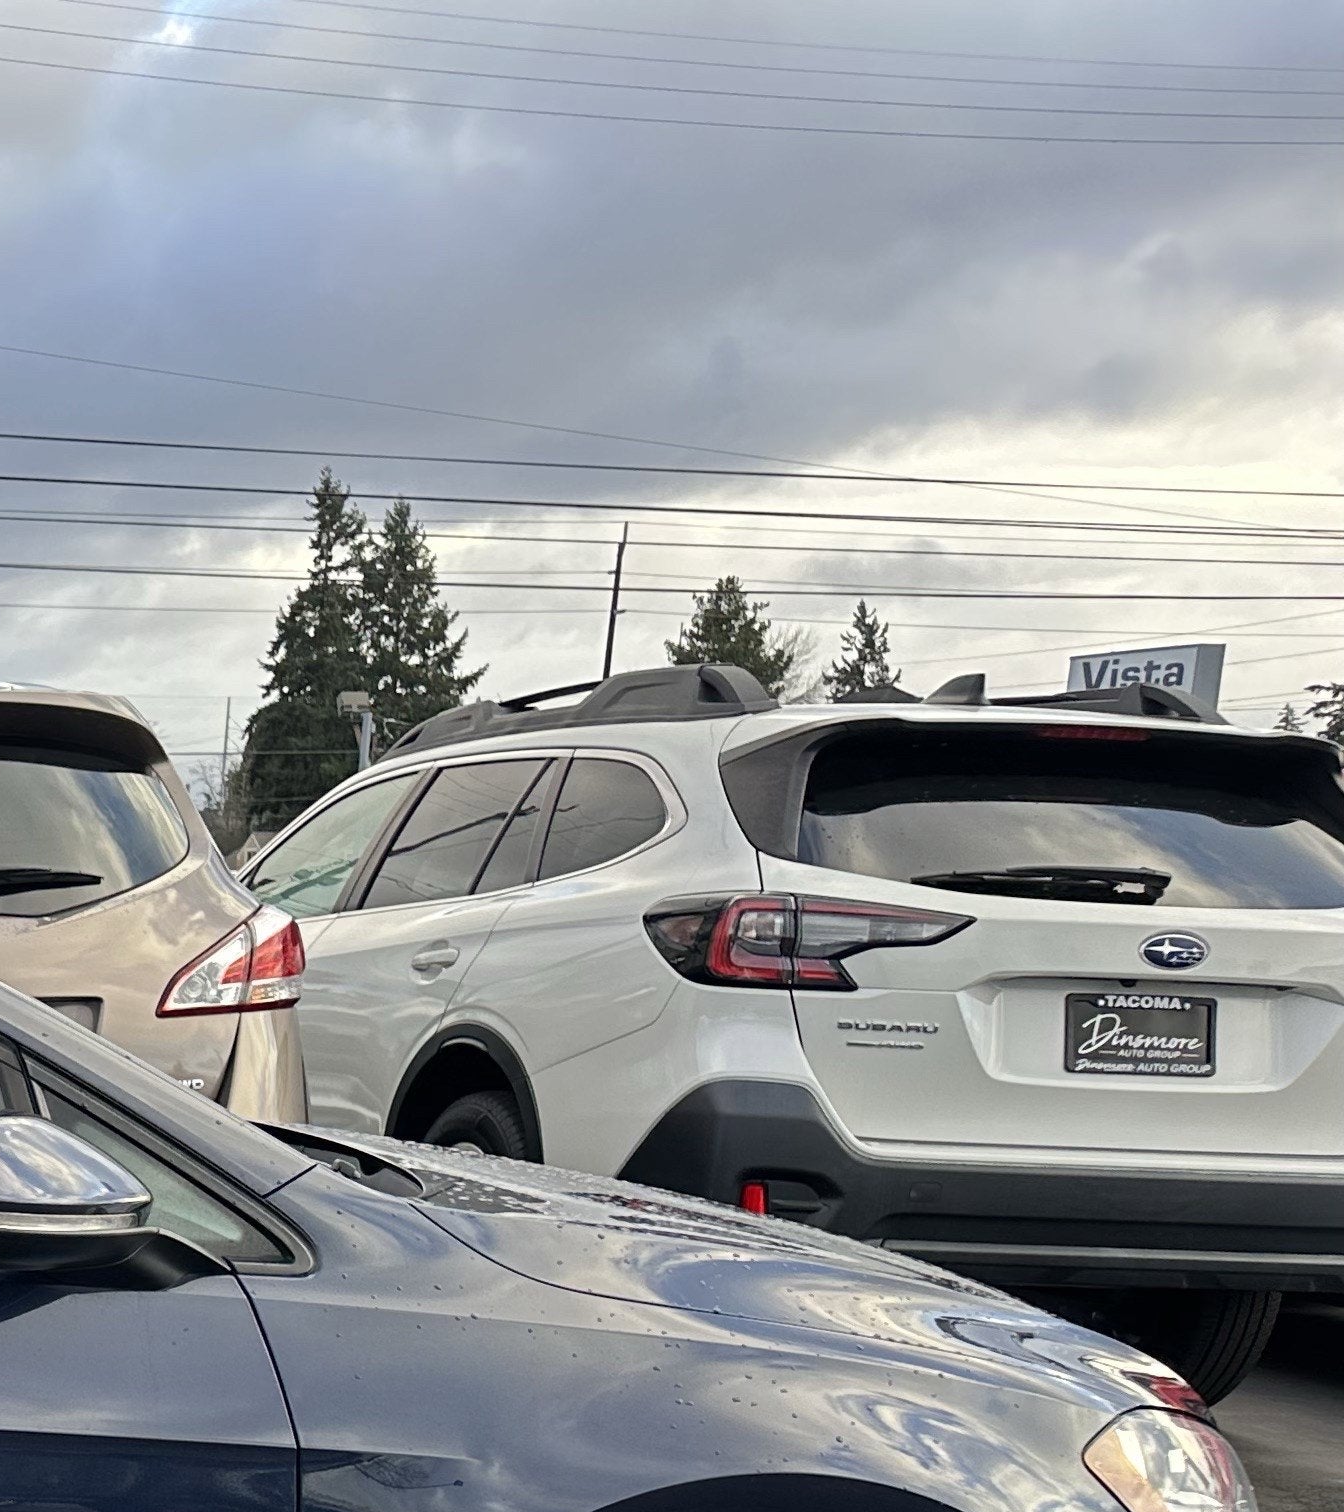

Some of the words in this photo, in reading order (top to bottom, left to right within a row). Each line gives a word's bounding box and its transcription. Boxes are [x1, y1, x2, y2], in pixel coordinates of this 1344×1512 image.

[1082, 658, 1185, 689] Vista
[1104, 995, 1182, 1010] TACOMA
[837, 1020, 939, 1034] SUBARU
[1077, 1013, 1205, 1055] Dinsmore
[1117, 1050, 1144, 1058] AUTO
[1146, 1051, 1182, 1059] GROUP
[1136, 1062, 1168, 1073] AUTO
[1170, 1063, 1211, 1074] GROUP
